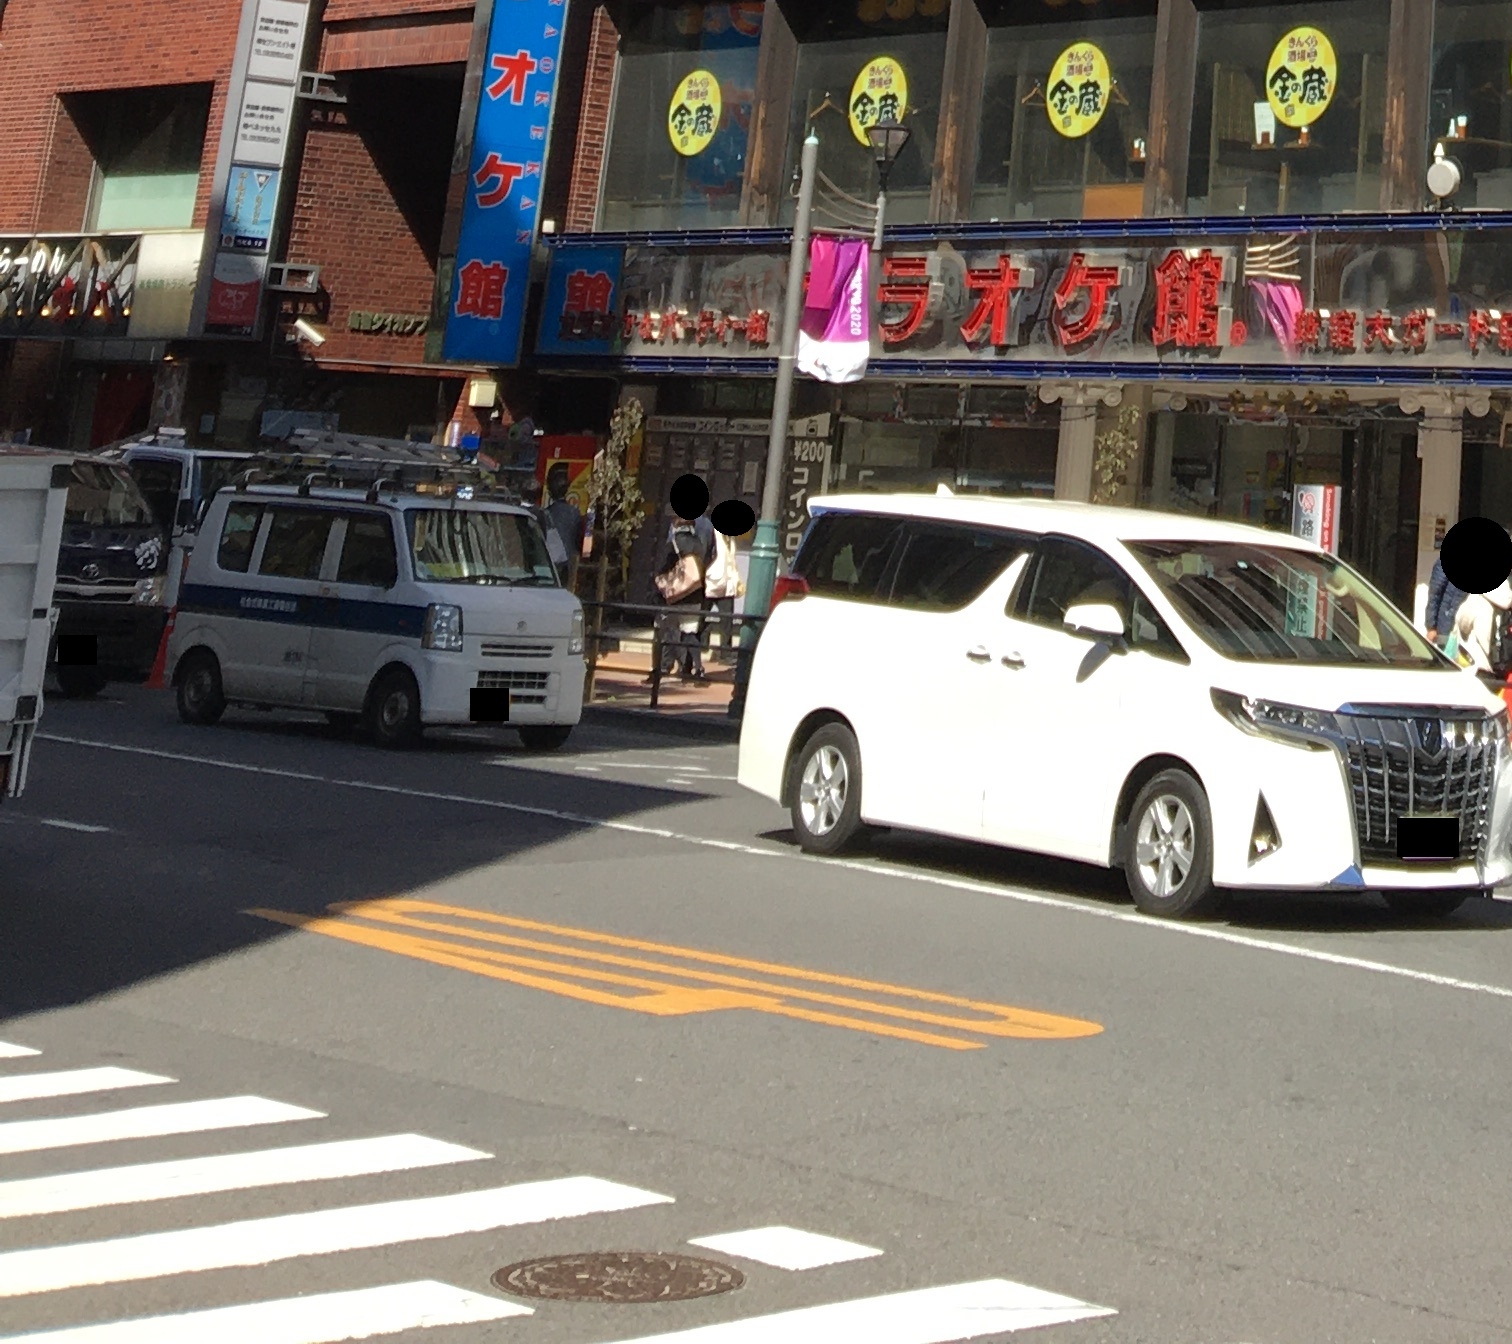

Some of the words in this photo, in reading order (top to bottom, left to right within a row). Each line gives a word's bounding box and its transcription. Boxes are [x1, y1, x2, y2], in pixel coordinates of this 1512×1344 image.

[1049, 79, 1104, 117] 金の蔵
[1269, 64, 1330, 104] 金の蔵
[671, 102, 713, 137] 金の蔵
[805, 248, 1224, 348] ラオケ館
[850, 304, 862, 336] 2020
[794, 440, 825, 462] ¥200
